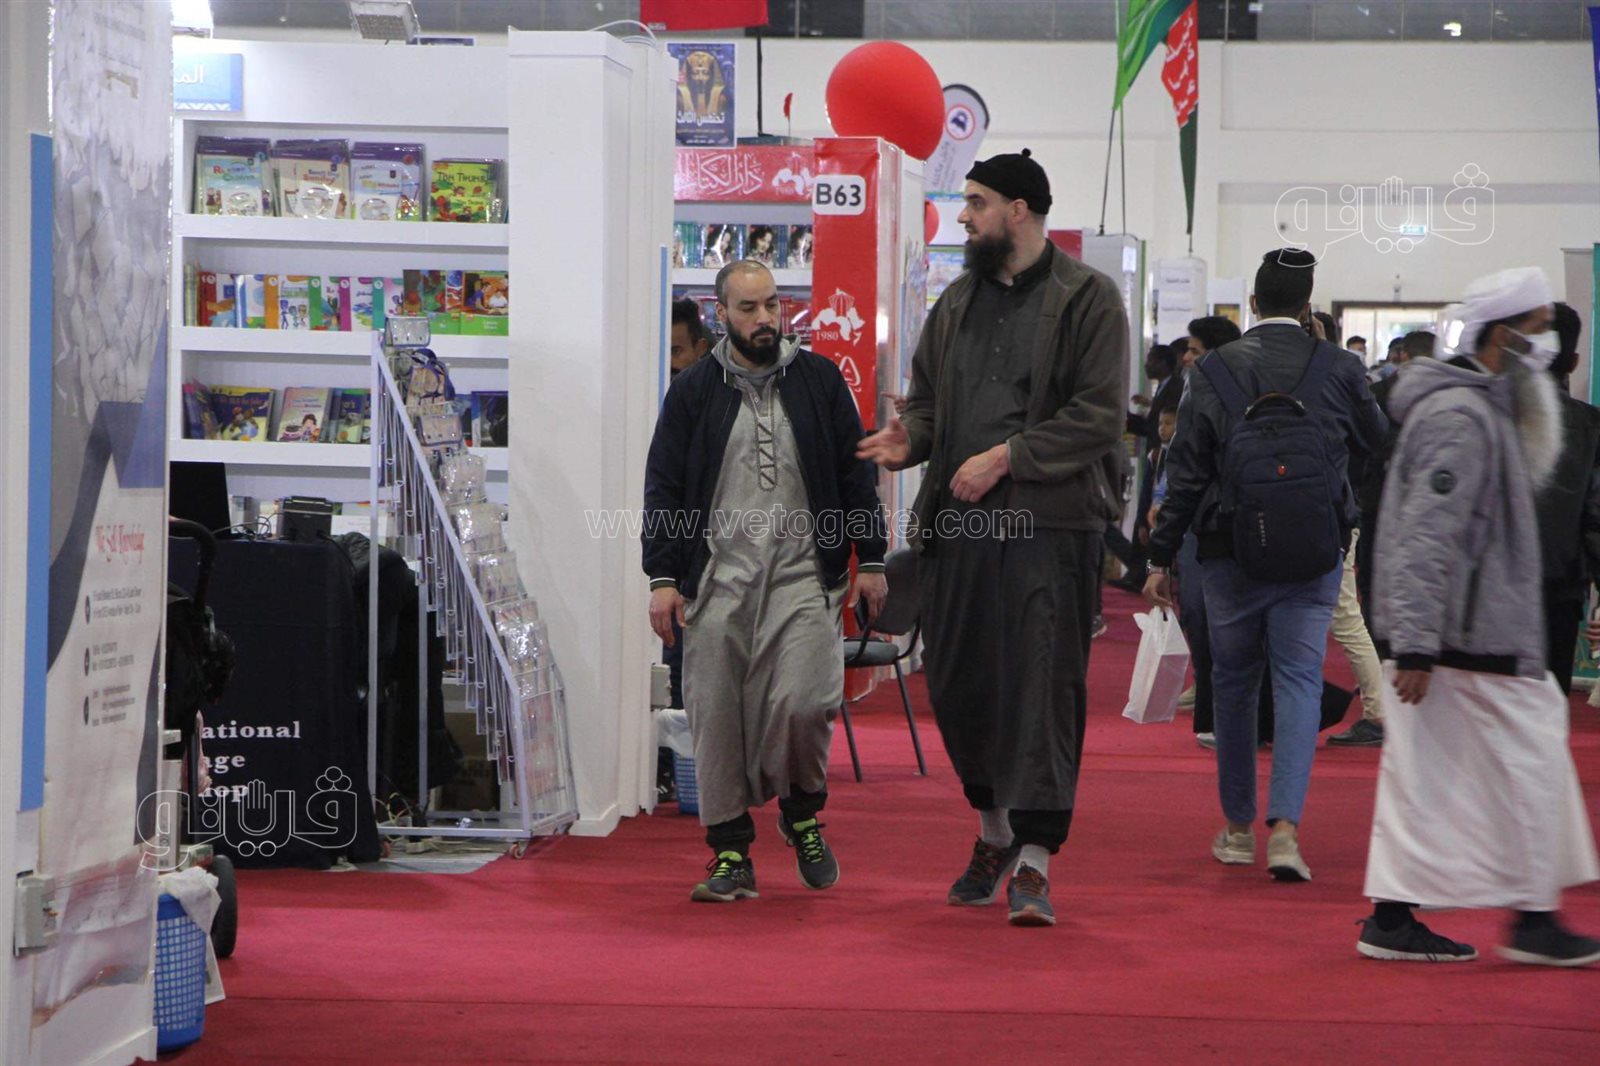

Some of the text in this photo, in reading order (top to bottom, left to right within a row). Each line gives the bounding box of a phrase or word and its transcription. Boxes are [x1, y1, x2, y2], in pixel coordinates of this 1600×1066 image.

[815, 184, 862, 207] B63
[816, 331, 839, 341] 1980
[202, 720, 301, 739] ational
